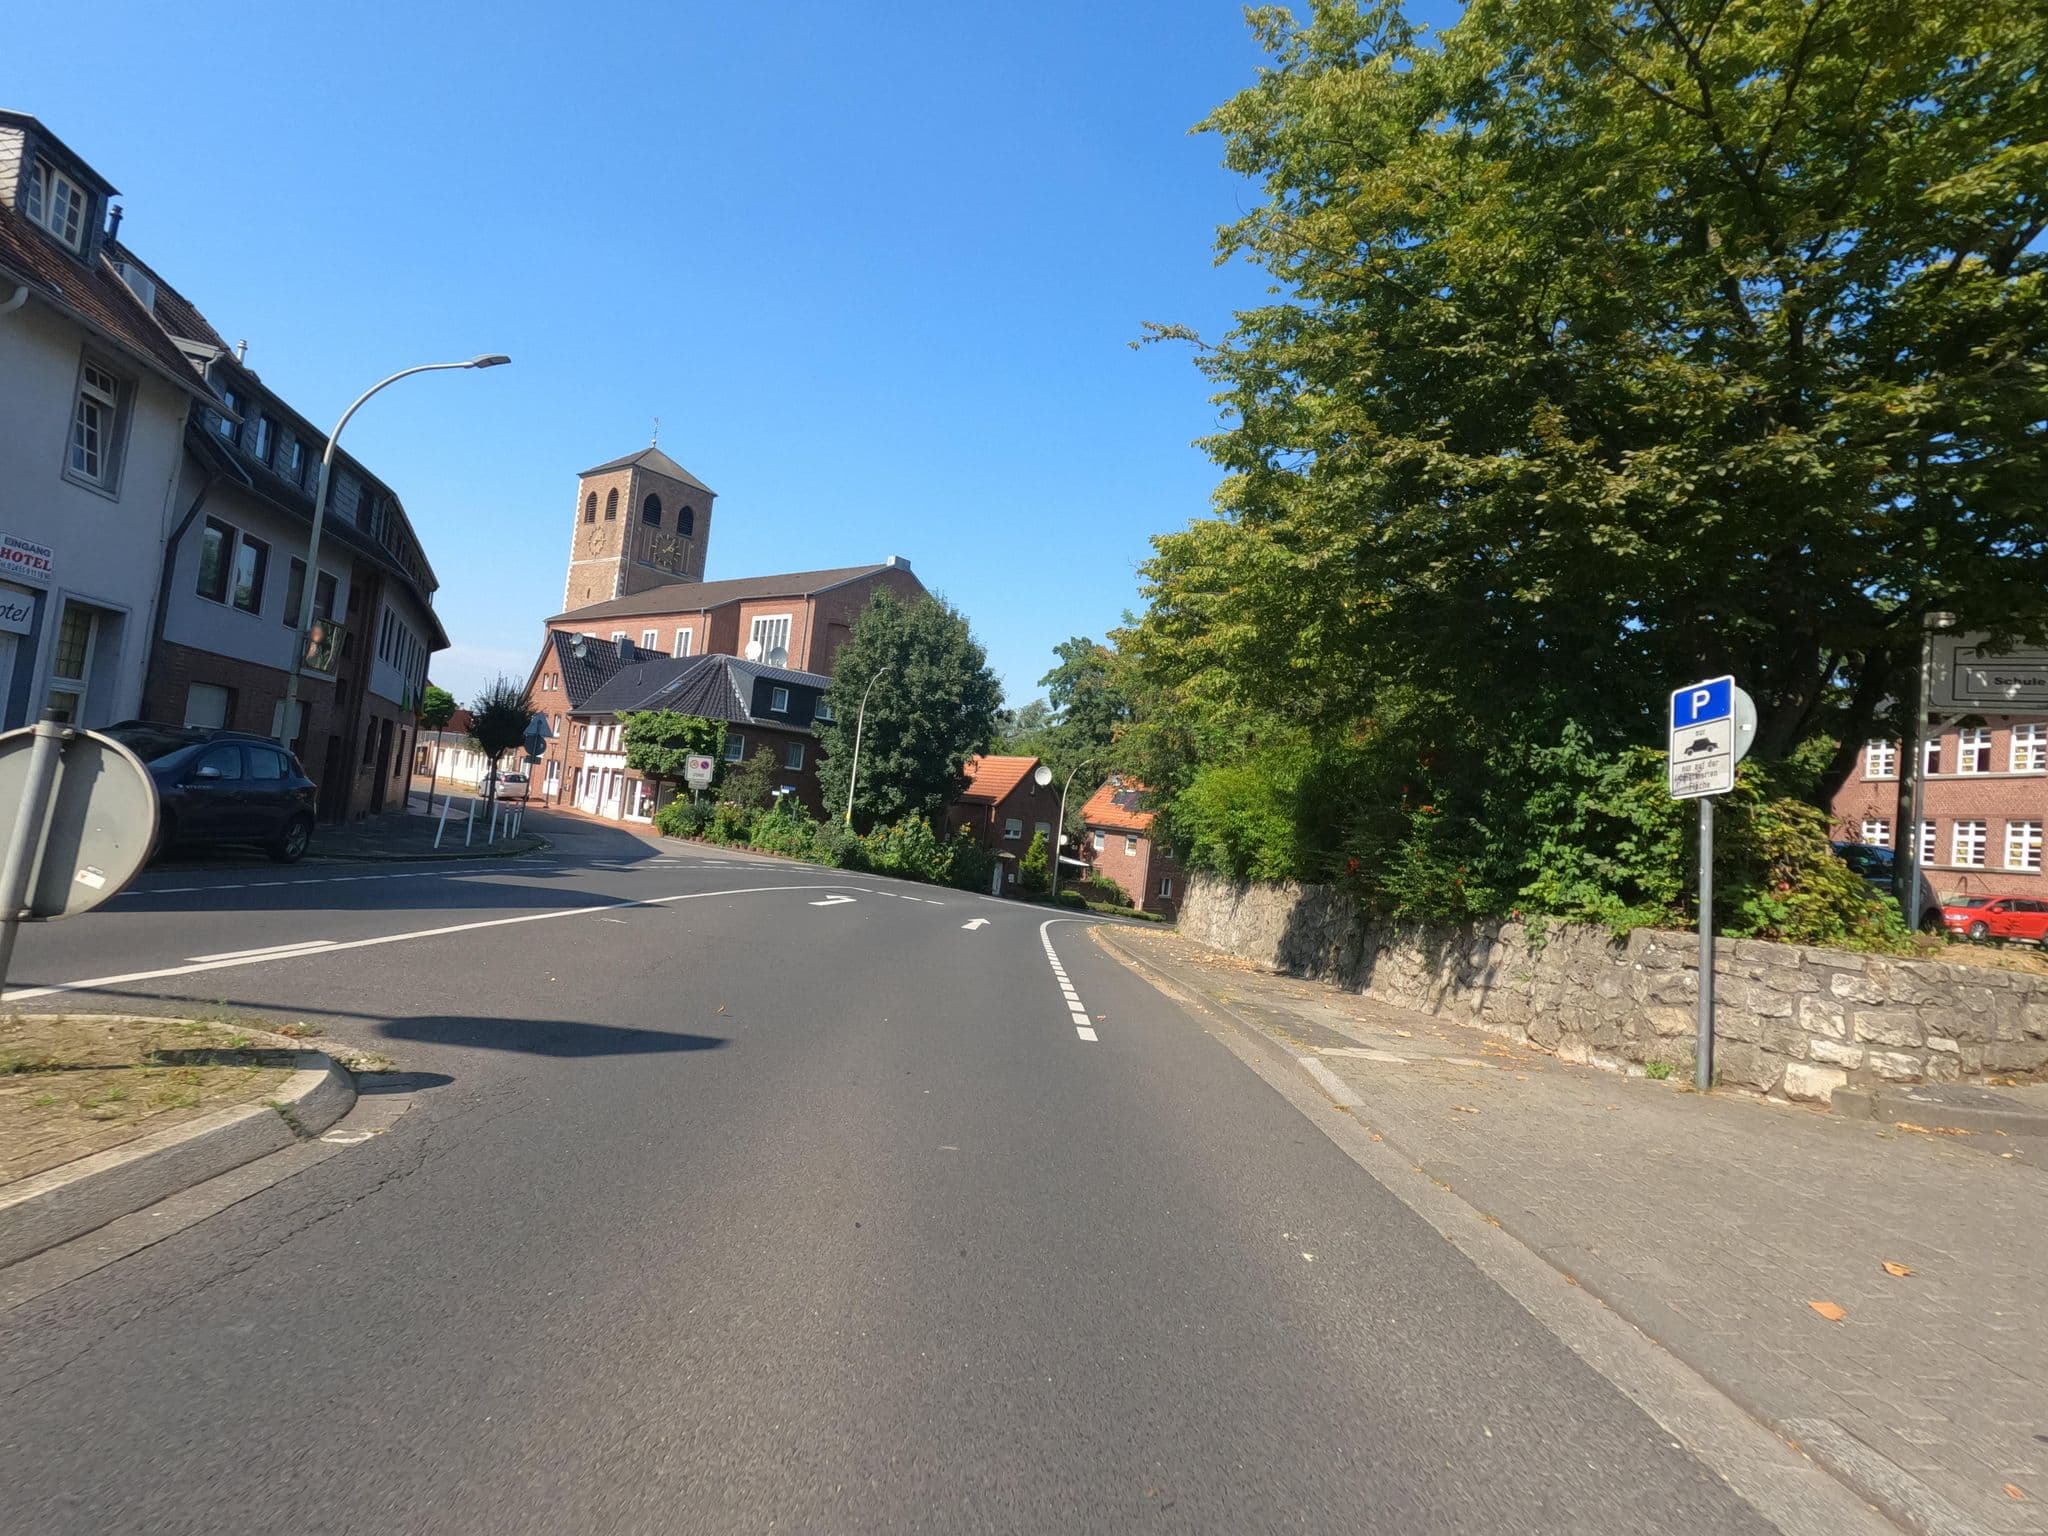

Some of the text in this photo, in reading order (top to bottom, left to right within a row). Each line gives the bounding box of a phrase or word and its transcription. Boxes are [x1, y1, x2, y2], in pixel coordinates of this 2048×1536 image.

[4, 537, 51, 557] EINGANG
[0, 546, 52, 571] HOTEL
[1994, 677, 2046, 686] Schule
[1692, 689, 1710, 719] P
